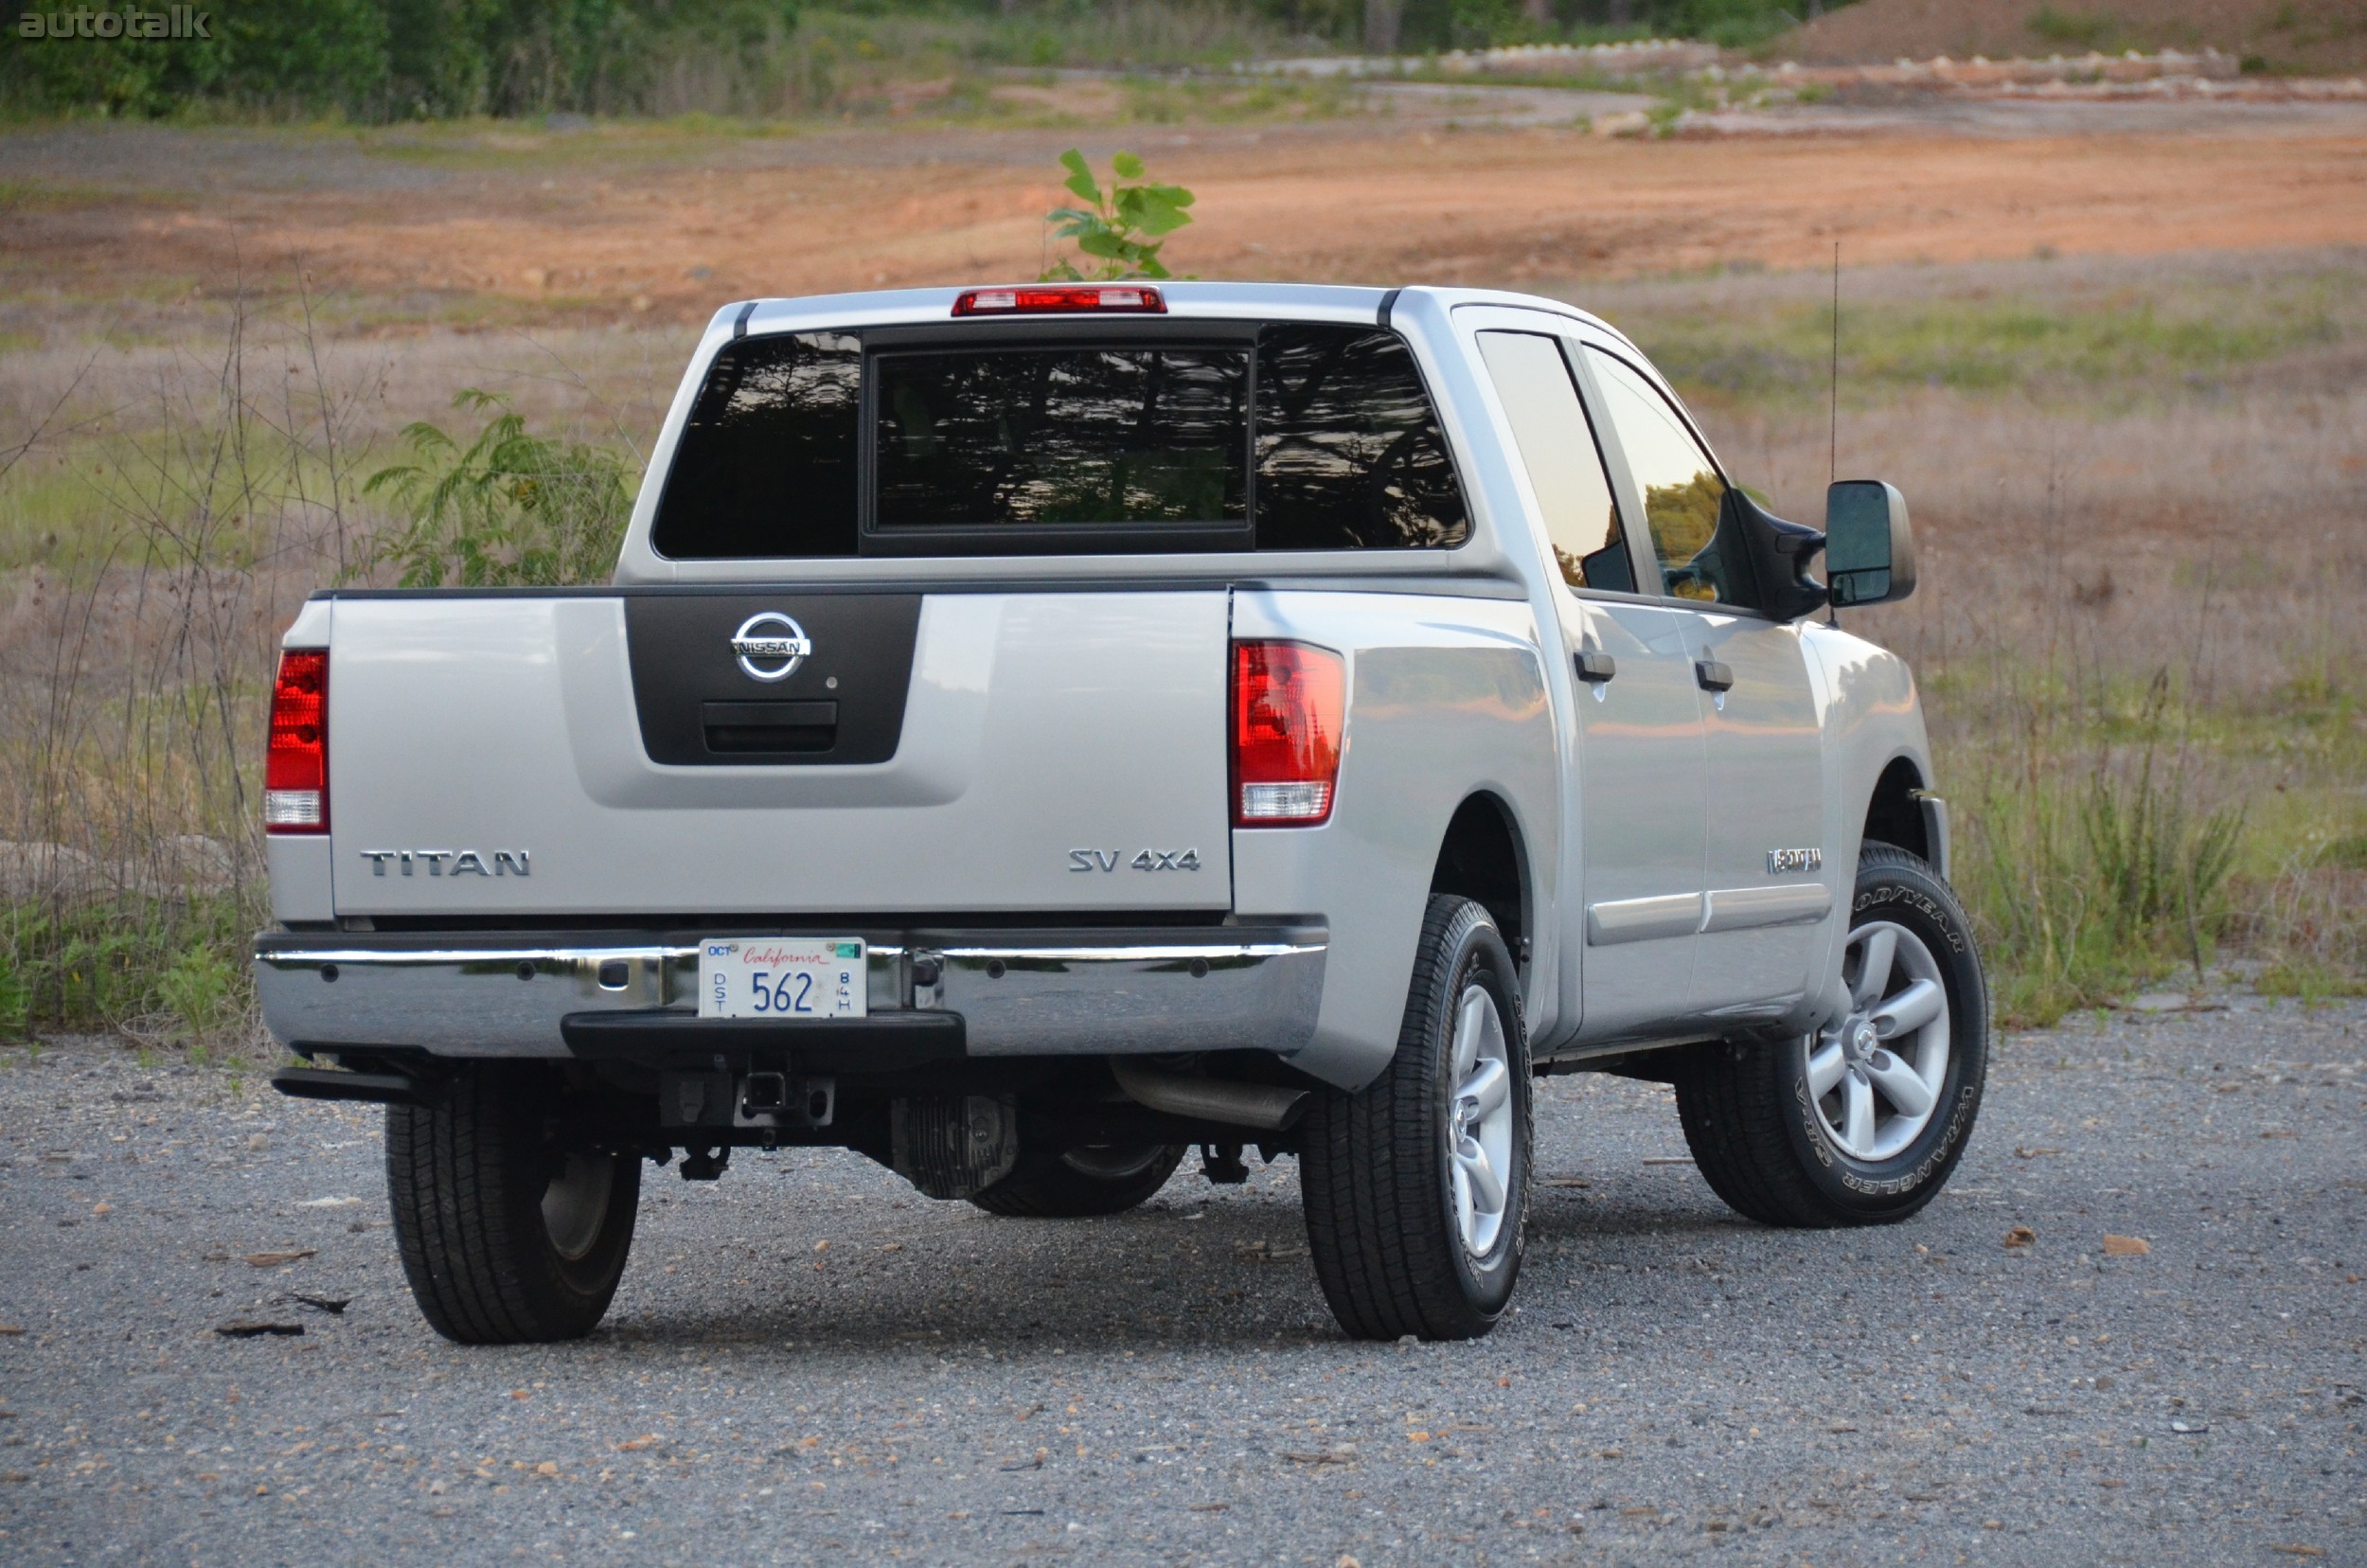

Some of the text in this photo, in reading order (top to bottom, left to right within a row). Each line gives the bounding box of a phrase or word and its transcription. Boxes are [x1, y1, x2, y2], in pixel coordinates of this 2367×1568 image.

[738, 641, 801, 654] NISSAN
[360, 849, 530, 877] TITAN
[1069, 848, 1121, 872] SV
[708, 946, 730, 956] OCT
[743, 946, 829, 968] California
[752, 971, 812, 1012] 562
[1842, 1085, 1974, 1195] WRANGLER
